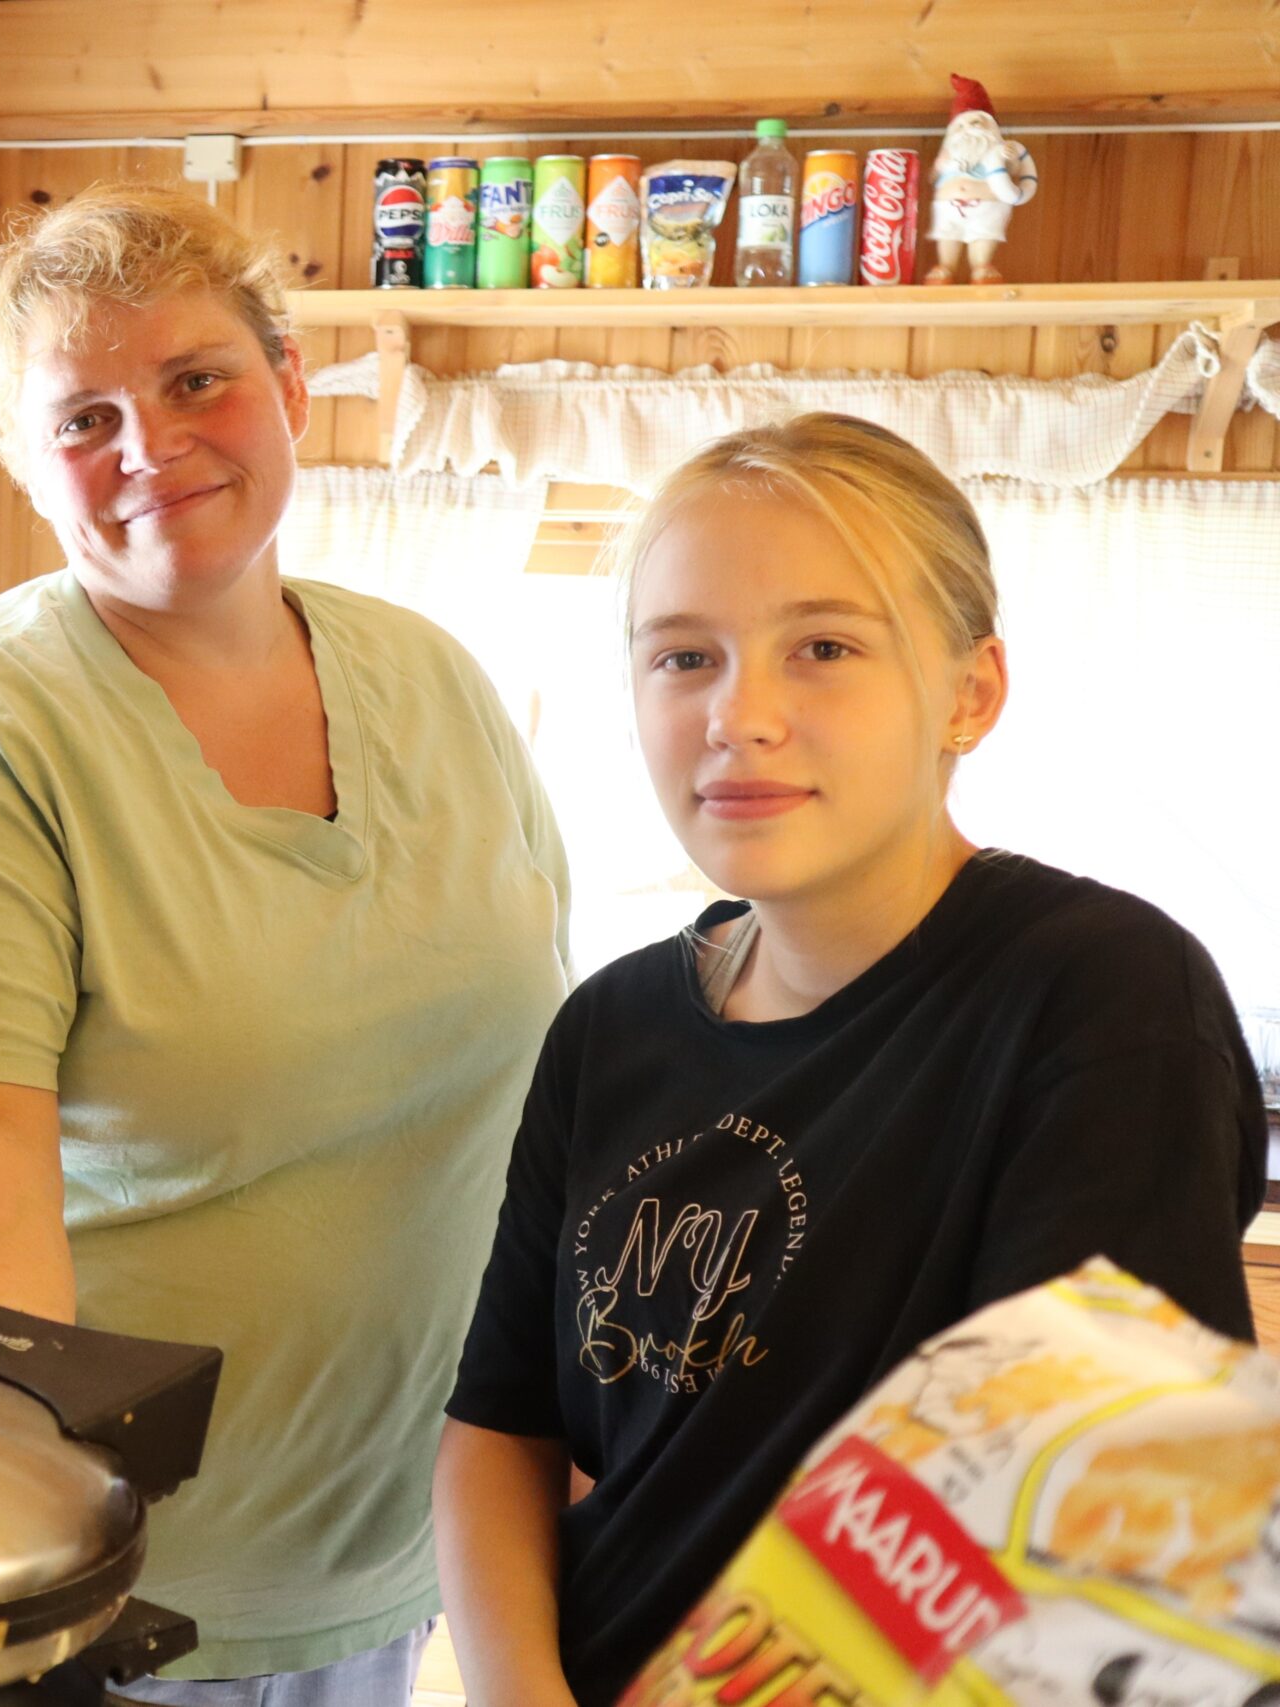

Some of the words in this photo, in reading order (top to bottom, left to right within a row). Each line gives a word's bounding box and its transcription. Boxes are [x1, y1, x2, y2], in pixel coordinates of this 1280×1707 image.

[480, 179, 532, 207] FANT
[378, 208, 423, 221] PEPS
[750, 203, 789, 217] LOKA
[801, 181, 857, 227] INGO
